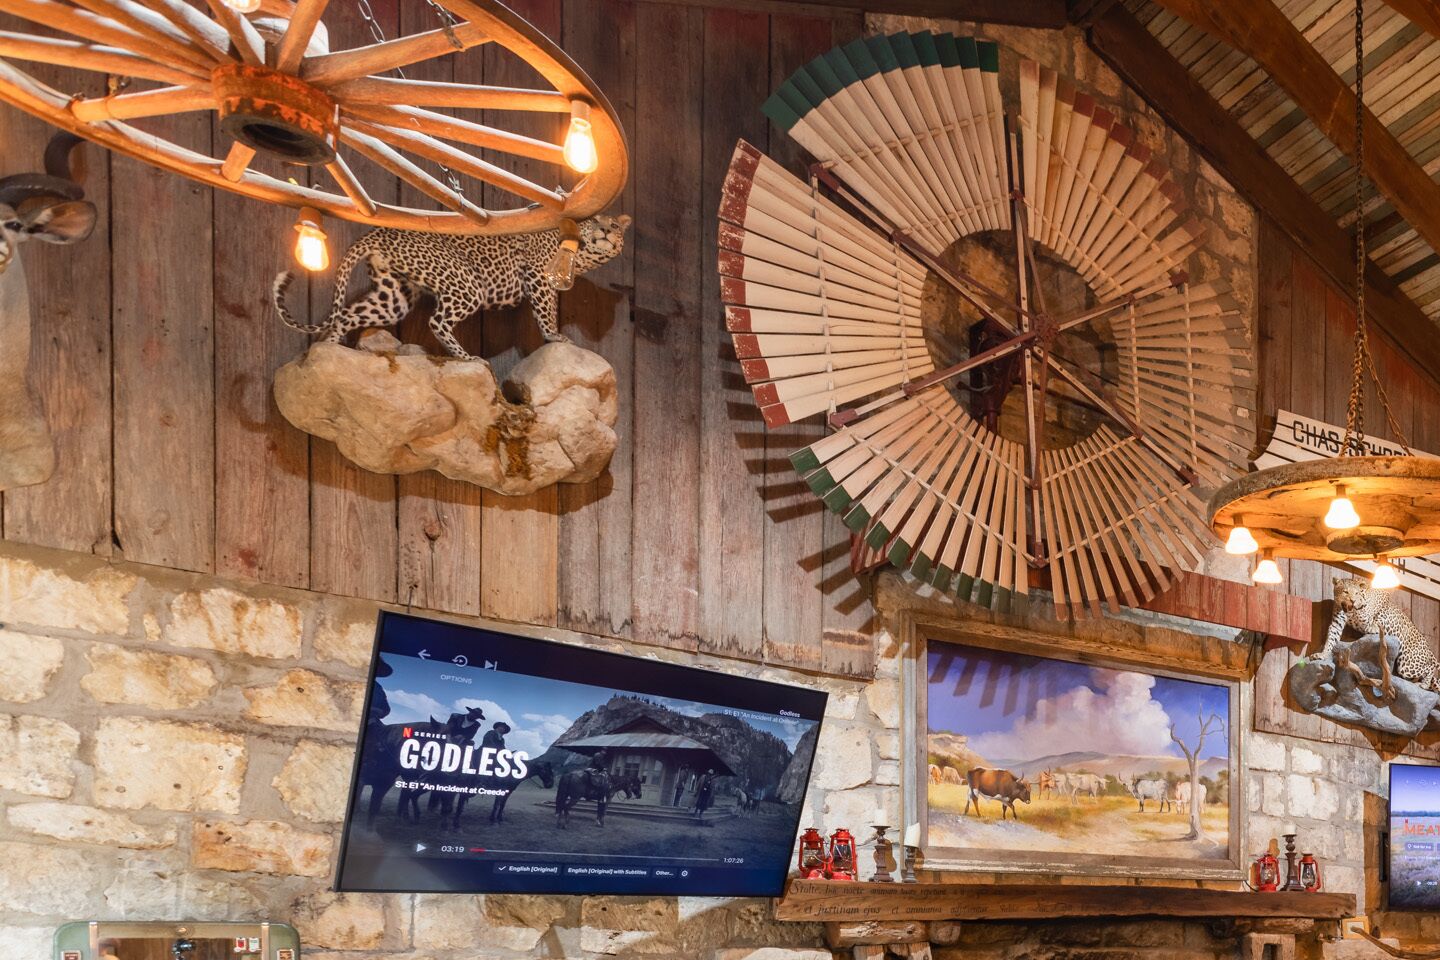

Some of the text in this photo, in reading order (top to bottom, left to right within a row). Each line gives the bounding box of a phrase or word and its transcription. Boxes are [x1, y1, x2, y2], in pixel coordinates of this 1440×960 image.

[440, 674, 473, 685] OPTIONS
[779, 709, 801, 718] Godless
[414, 731, 447, 740] SERIES
[399, 738, 529, 780] GODLESS
[395, 780, 408, 789] S1:
[409, 781, 419, 790] E1
[436, 784, 468, 794] Incident
[440, 845, 465, 853] 03:19
[508, 865, 531, 873] English
[567, 867, 588, 875] English
